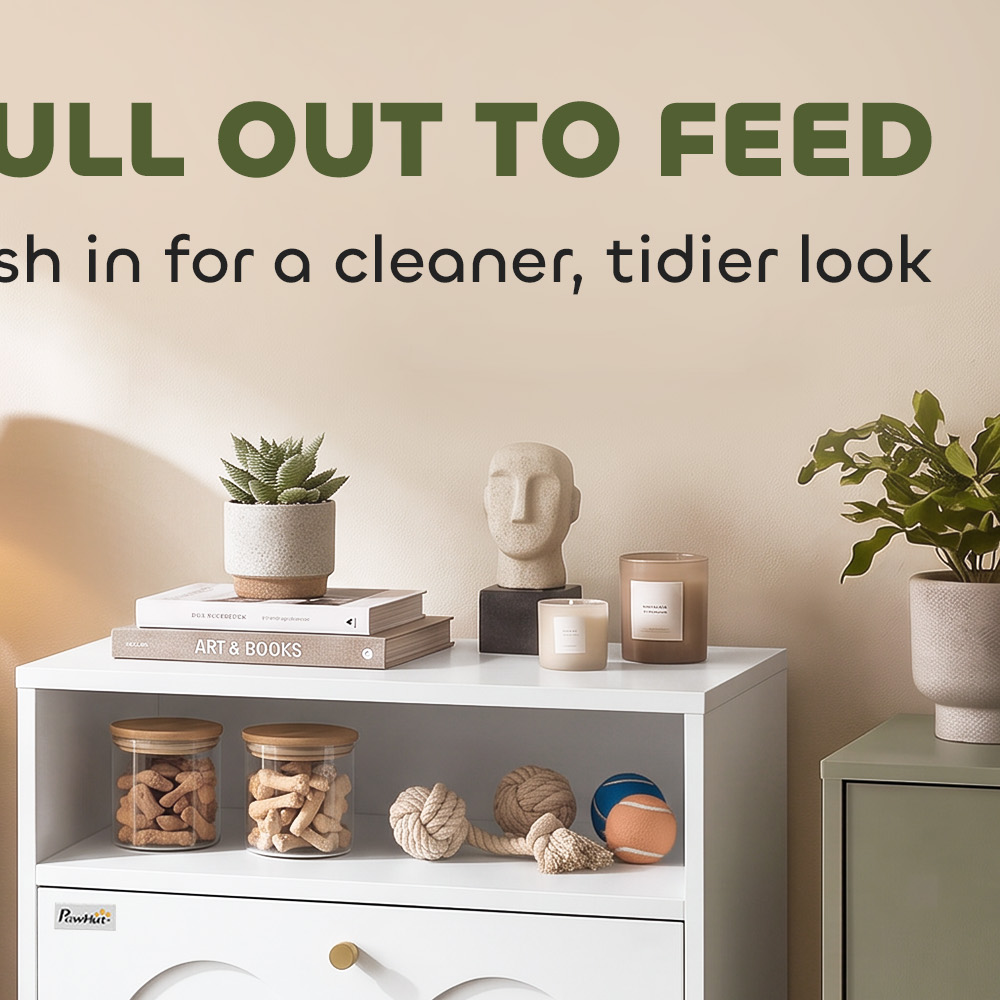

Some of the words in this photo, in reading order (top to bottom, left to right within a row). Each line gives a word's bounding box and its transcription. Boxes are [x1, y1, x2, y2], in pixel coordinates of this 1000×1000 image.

[195, 639, 226, 655] ART
[228, 641, 240, 656] &
[245, 641, 302, 658] BOOKS
[58, 908, 106, 924] PawHut
